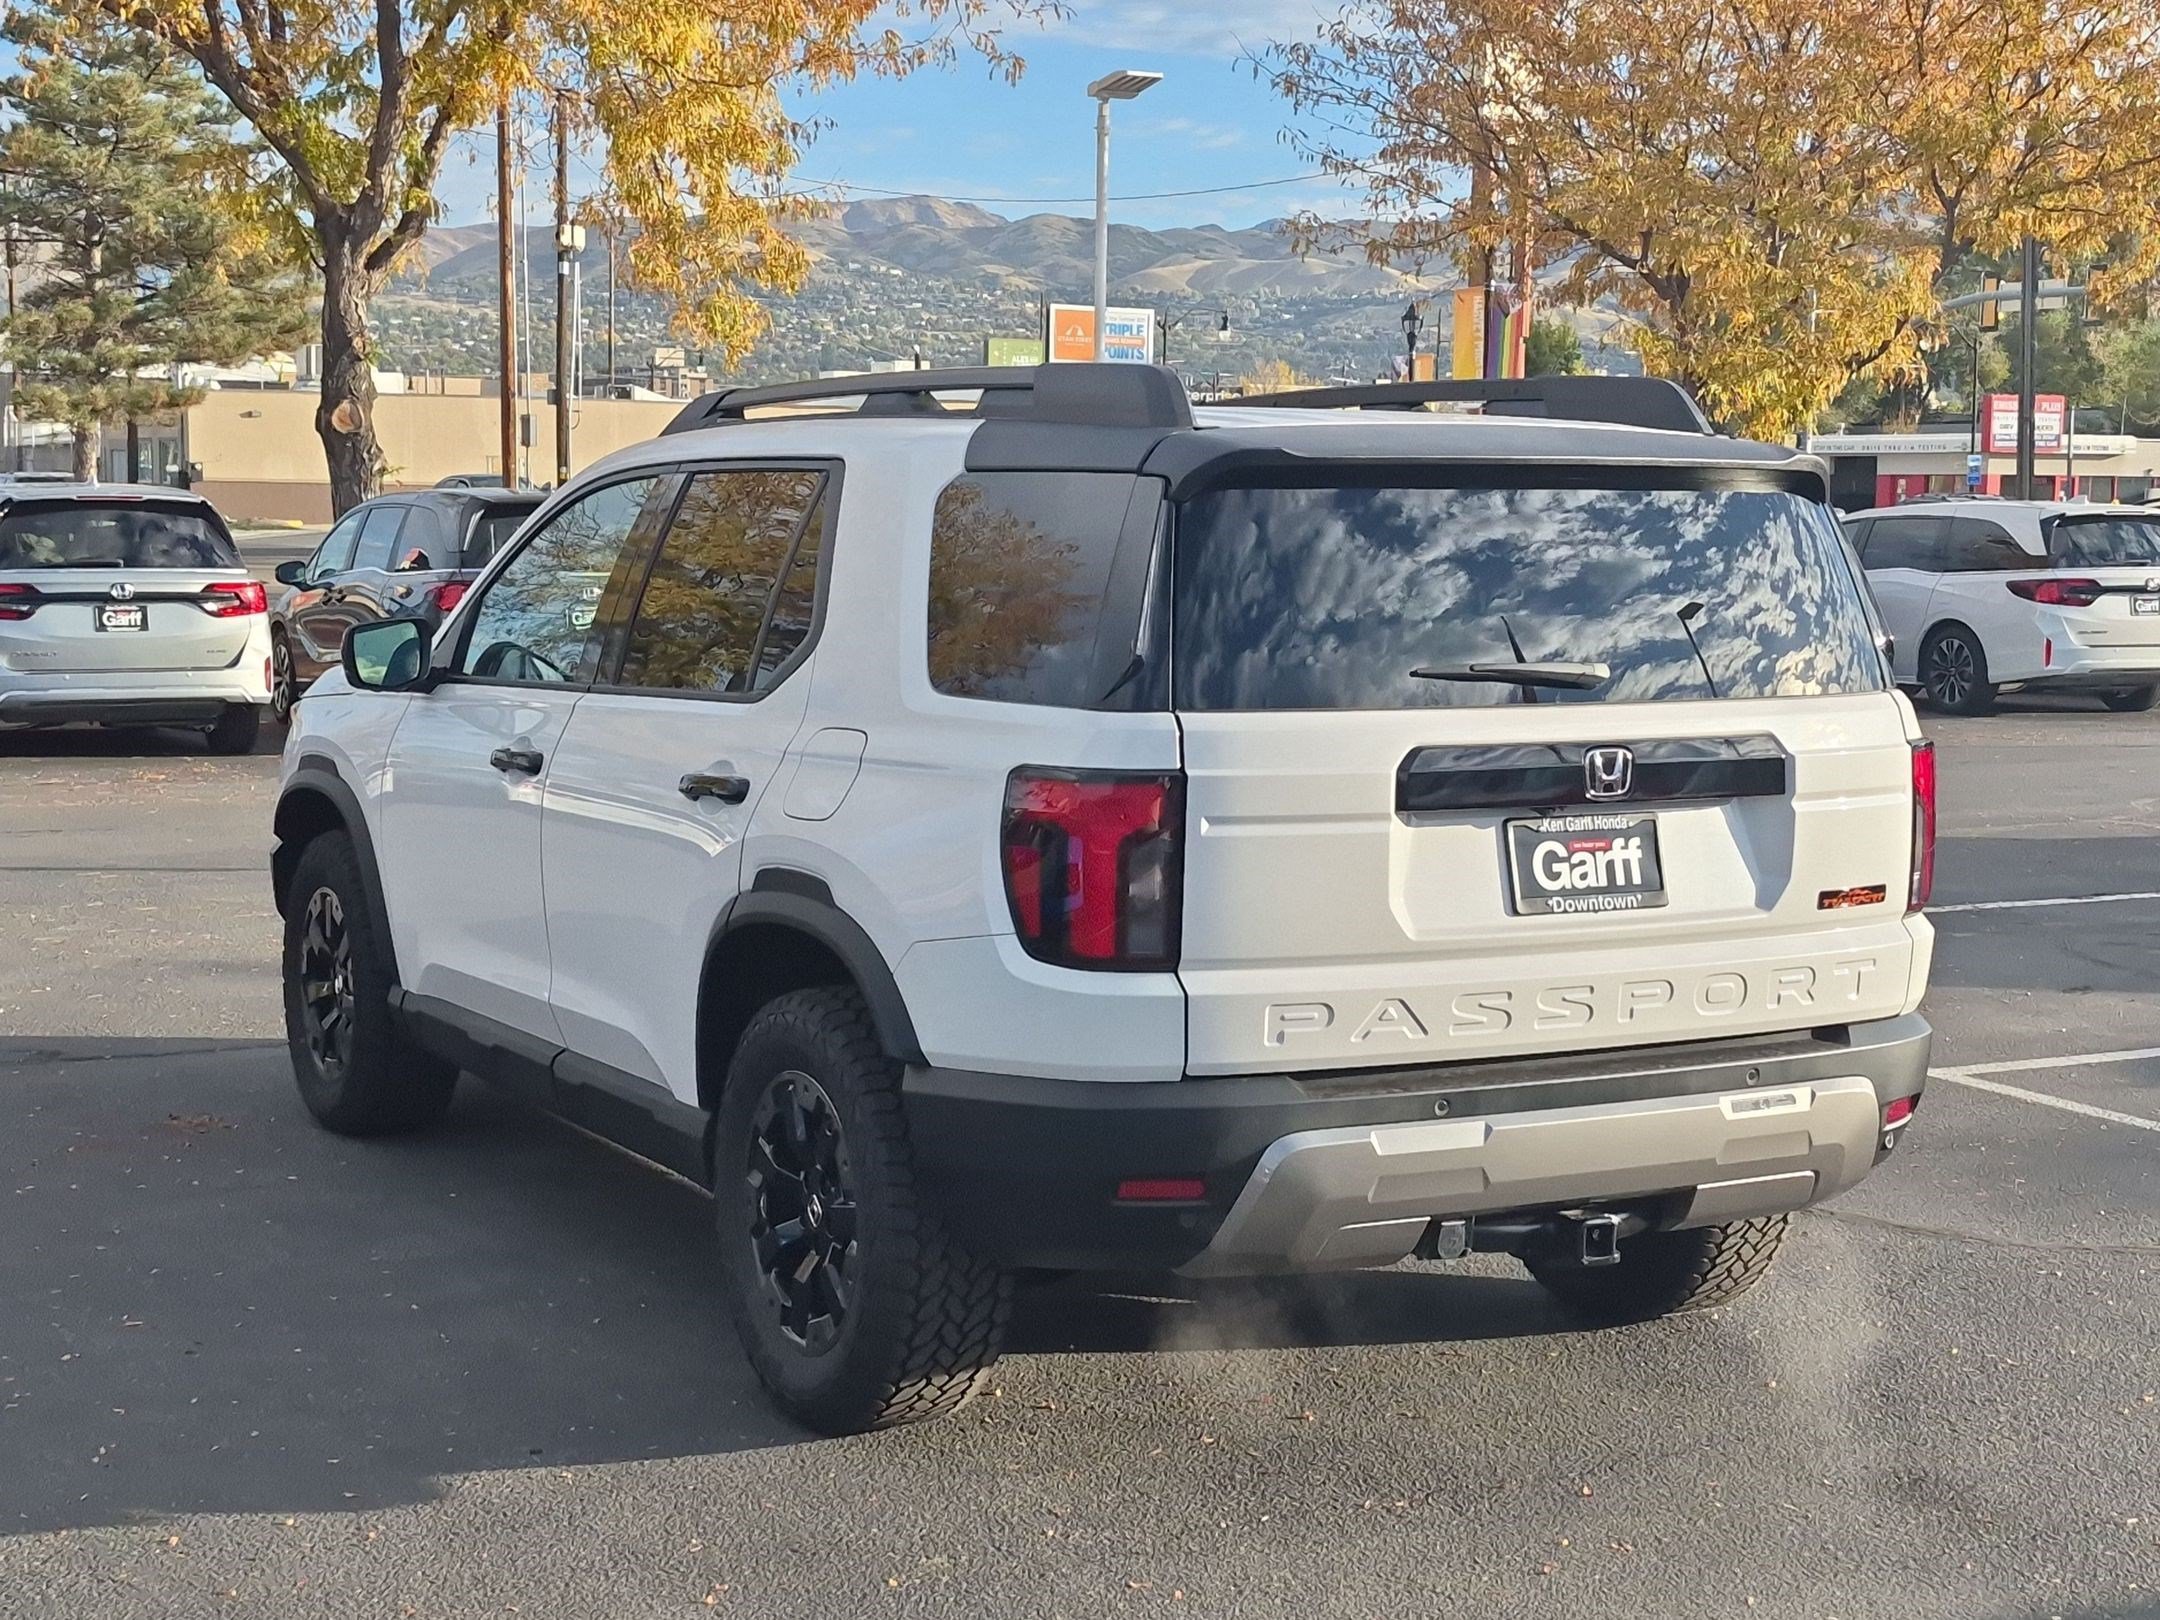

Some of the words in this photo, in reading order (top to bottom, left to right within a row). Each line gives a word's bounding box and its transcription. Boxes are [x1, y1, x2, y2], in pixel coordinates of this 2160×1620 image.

[1104, 323, 1144, 336] TRIPLE
[102, 611, 142, 626] Garff
[1542, 818, 1564, 832] Ken
[1566, 816, 1593, 831] Garff
[1595, 815, 1628, 830] Honda
[1532, 837, 1642, 891] Garff
[1552, 895, 1638, 913] Downtown
[1264, 959, 1877, 1048] PASSPORT
